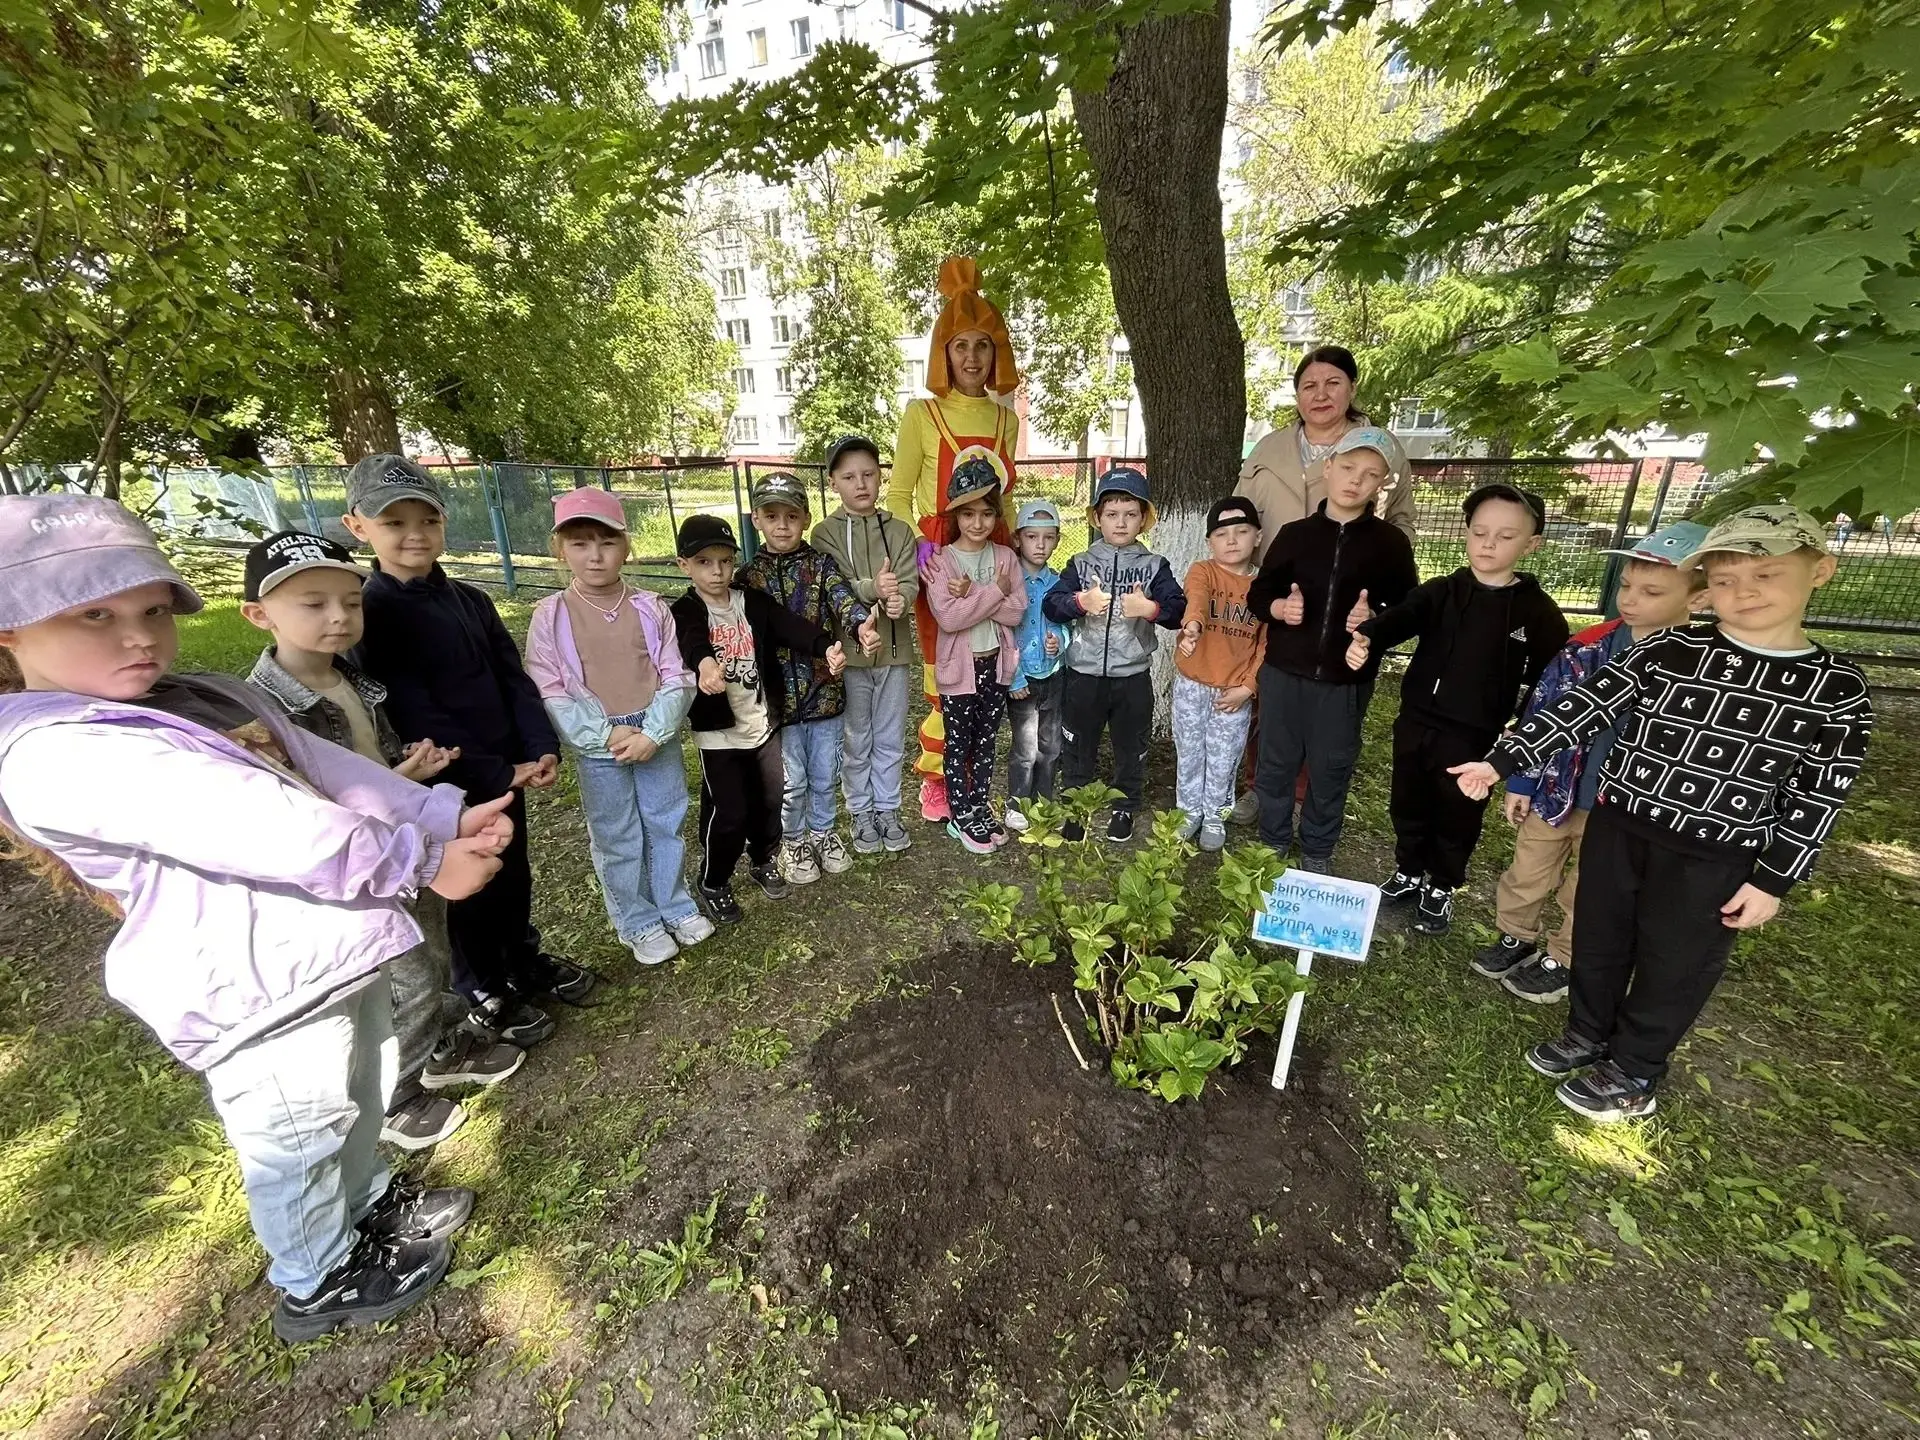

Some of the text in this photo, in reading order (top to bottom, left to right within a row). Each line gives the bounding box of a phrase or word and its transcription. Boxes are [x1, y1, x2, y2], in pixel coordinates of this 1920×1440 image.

[266, 534, 333, 560] ATHLETIC
[1720, 669, 1735, 681] 5
[1781, 671, 1797, 685] U
[1596, 677, 1611, 689] E
[1557, 700, 1573, 711] D
[1681, 696, 1696, 710] K
[1736, 707, 1751, 722] E
[1522, 722, 1537, 733] D
[1792, 719, 1807, 733] T
[1707, 745, 1724, 759] D
[1635, 765, 1652, 780] W
[1760, 759, 1777, 773] Z
[1680, 781, 1697, 795] D
[1789, 777, 1799, 788] 6
[1833, 774, 1853, 789] W
[1730, 795, 1748, 811] Q
[1789, 809, 1805, 821] P
[1269, 898, 1302, 914] 2026
[1264, 914, 1316, 934] ГРУППА
[1343, 929, 1359, 942] 91
